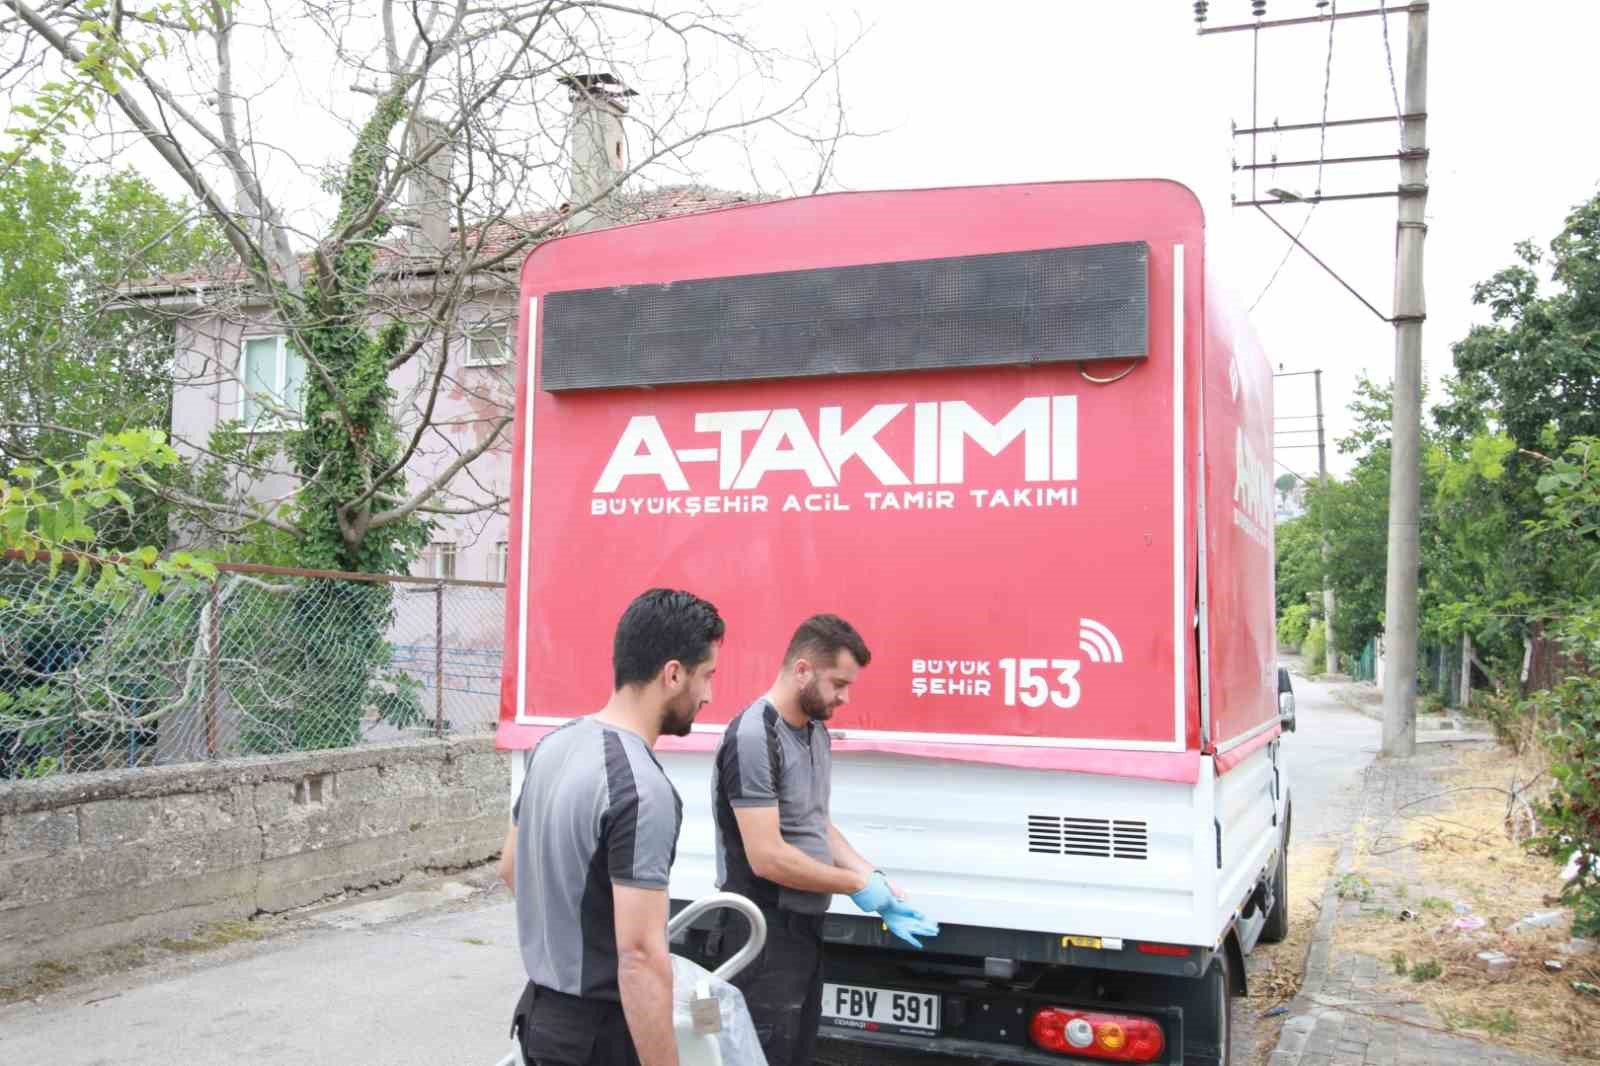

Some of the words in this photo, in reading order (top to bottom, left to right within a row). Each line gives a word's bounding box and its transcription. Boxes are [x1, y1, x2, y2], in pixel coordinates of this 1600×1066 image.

[593, 395, 1078, 493] A-TAKIMI
[970, 488, 1078, 509] TAKIMI
[912, 659, 990, 676] BÜYÜK
[999, 657, 1081, 709] 153
[836, 986, 878, 1018] FBV
[892, 993, 933, 1026] 591
